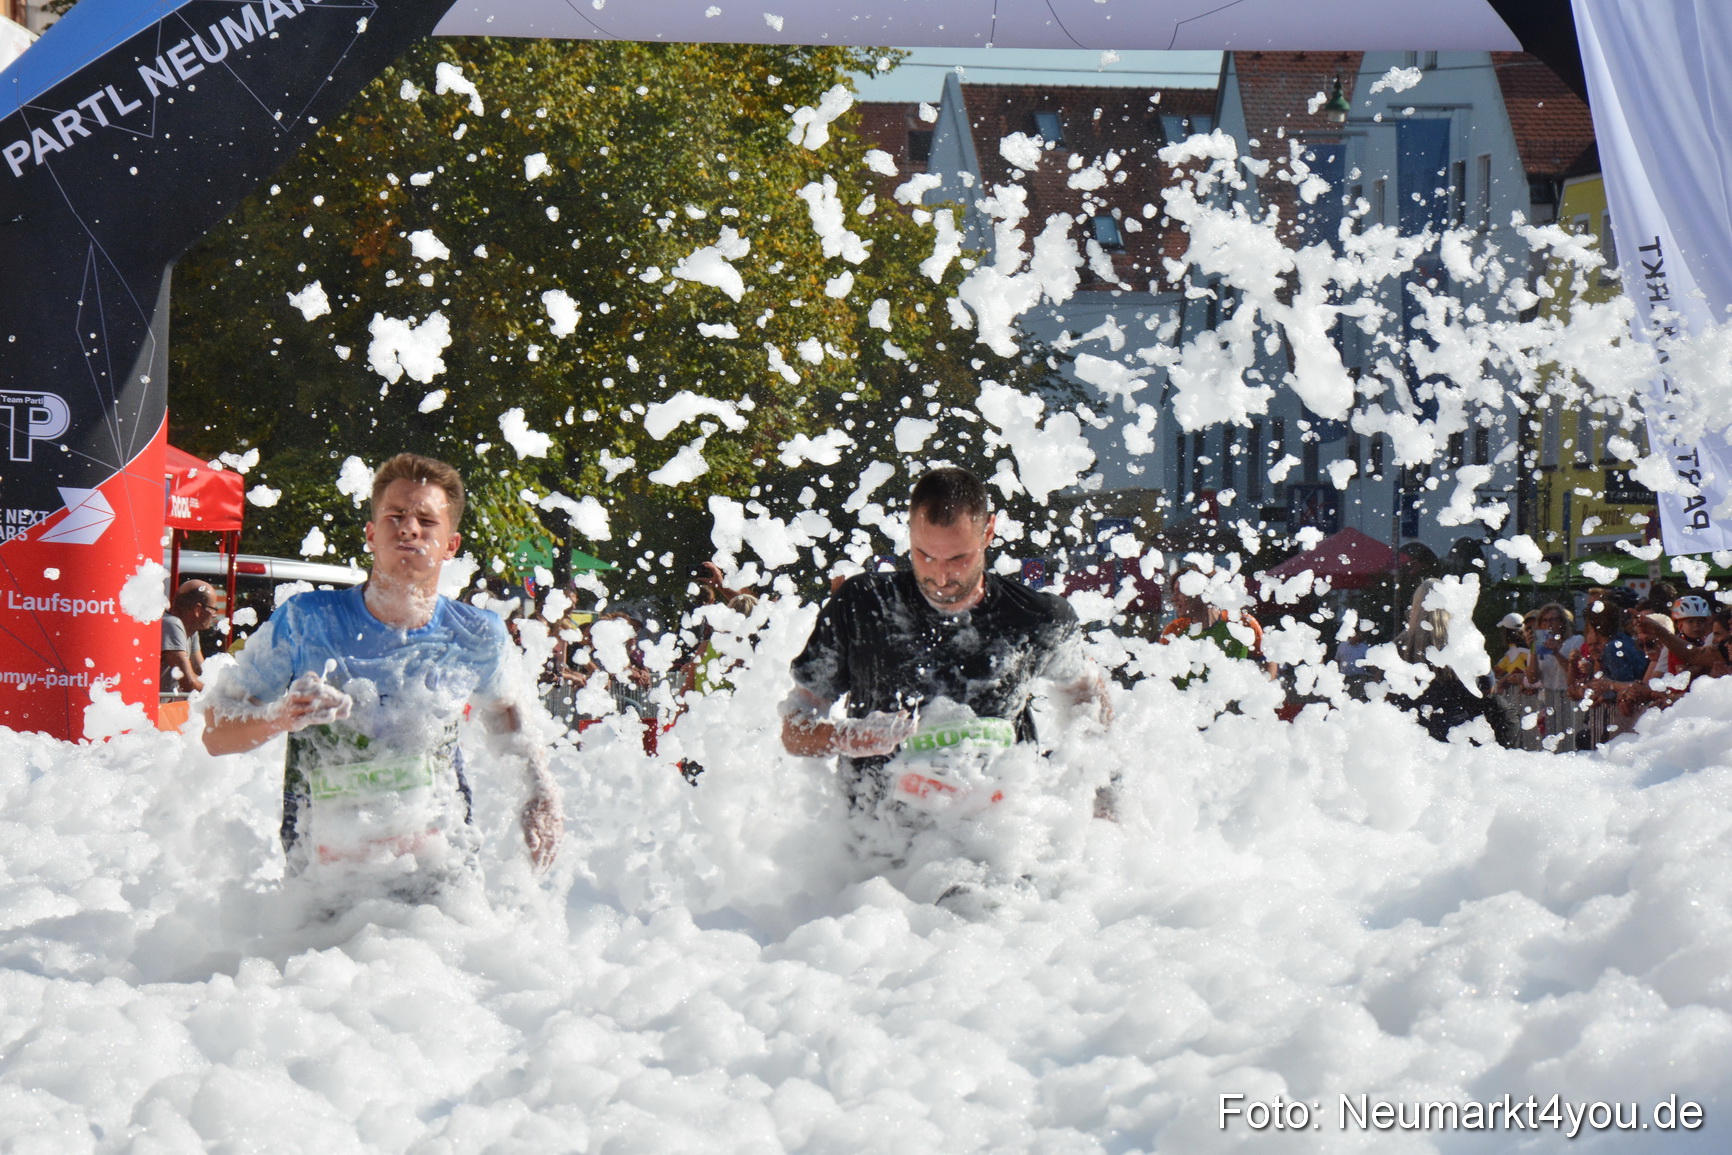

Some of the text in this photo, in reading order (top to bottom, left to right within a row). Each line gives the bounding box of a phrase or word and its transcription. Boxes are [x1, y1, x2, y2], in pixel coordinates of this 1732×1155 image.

[3, 84, 142, 178] PARTL
[6, 508, 50, 526] NEXT
[8, 590, 116, 617] Laufsport
